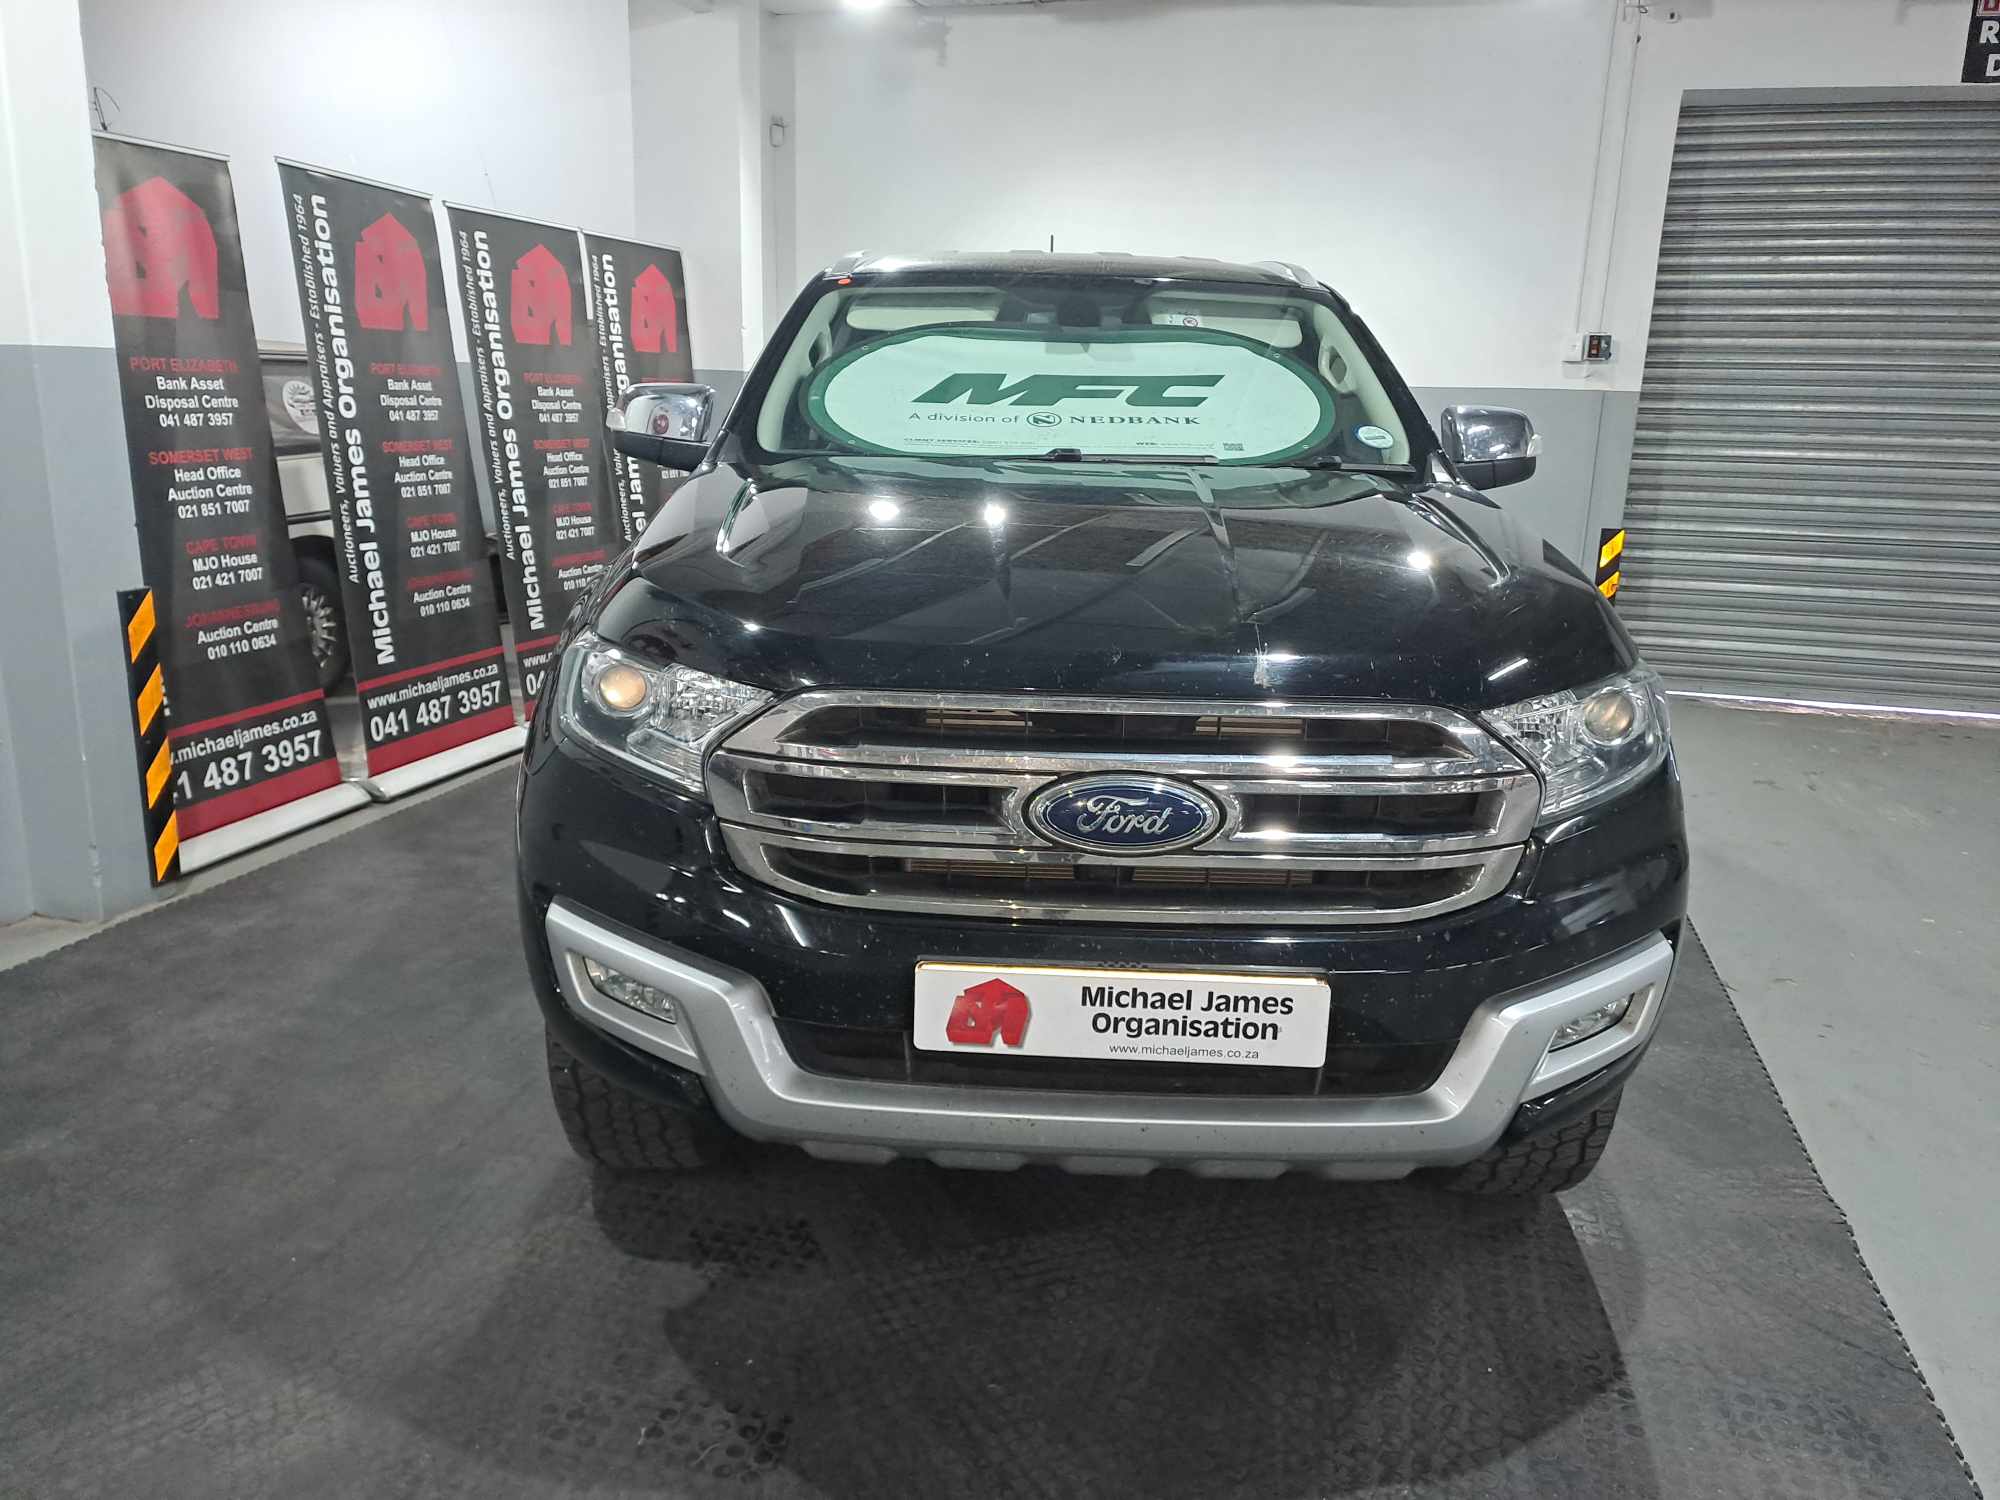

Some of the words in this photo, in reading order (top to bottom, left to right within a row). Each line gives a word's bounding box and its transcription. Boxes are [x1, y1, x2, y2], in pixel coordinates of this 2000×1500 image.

[292, 193, 307, 231] 1964
[459, 230, 471, 262] 1964
[298, 234, 320, 320] Established
[311, 194, 358, 418] Organisation
[463, 264, 482, 336] Established
[474, 230, 513, 420] Organisation
[156, 376, 188, 390] Bank
[190, 376, 224, 390] Asset
[315, 332, 332, 408] Appraisers
[476, 347, 493, 410] Appraisers
[388, 379, 409, 391] Bank
[411, 380, 432, 392] Asset
[910, 372, 1226, 407] MFC
[145, 395, 199, 410] Disposal
[202, 395, 239, 408] Centre
[380, 394, 418, 408] Disposal
[419, 396, 442, 406] Centre
[159, 414, 180, 427] 041
[184, 413, 204, 426] 487
[208, 412, 233, 426] 3957
[324, 410, 338, 438] and
[389, 410, 404, 422] 041
[484, 413, 496, 438] and
[908, 412, 920, 424] A
[927, 412, 998, 424] division
[1002, 414, 1019, 424] of
[1070, 415, 1201, 426] NEDBANK
[174, 468, 204, 482] Head
[207, 466, 241, 479] Office
[329, 441, 346, 494] Valuers
[398, 456, 420, 467] Head
[422, 455, 446, 466] Office
[490, 440, 504, 484] Valuers
[503, 428, 528, 518] James
[345, 428, 376, 533] James
[394, 472, 426, 483] Auction
[428, 470, 453, 480] Centre
[168, 486, 214, 501] Auction
[216, 484, 252, 496] Centre
[400, 486, 416, 498] 021
[418, 485, 432, 497] 851
[178, 504, 198, 519] 021
[201, 502, 221, 516] 851
[224, 500, 250, 514] 7007
[410, 531, 430, 544] MJO
[431, 529, 457, 542] House
[498, 488, 516, 560] Auctioneers,
[340, 500, 360, 584] Auctioneers,
[410, 546, 426, 558] 021
[426, 544, 441, 556] 421
[192, 556, 218, 572] MJO
[221, 553, 258, 568] House
[192, 576, 212, 590] 021
[216, 572, 236, 586] 421
[238, 567, 263, 583] 7007
[514, 526, 545, 631] Michael
[359, 542, 396, 665] Michael
[413, 590, 445, 604] Auction
[446, 584, 472, 598] Centre
[420, 604, 434, 618] 010
[436, 601, 450, 614] 110
[198, 626, 242, 644] Auction
[244, 618, 279, 634] Centre
[208, 646, 228, 660] 010
[230, 640, 250, 655] 110
[252, 634, 276, 650] 0634
[368, 664, 498, 710] www.michaeljames.co.za
[370, 708, 409, 742] 041
[416, 695, 452, 727] 487
[458, 680, 501, 714] 3957
[203, 751, 253, 790] 487
[262, 730, 322, 772] 3957
[1077, 795, 1173, 834] Ford
[1081, 986, 1193, 1012] Michael
[1201, 990, 1294, 1016] James
[1091, 1012, 1280, 1042] Organisation
[1109, 1043, 1260, 1060] www.michaeljames.co.za
